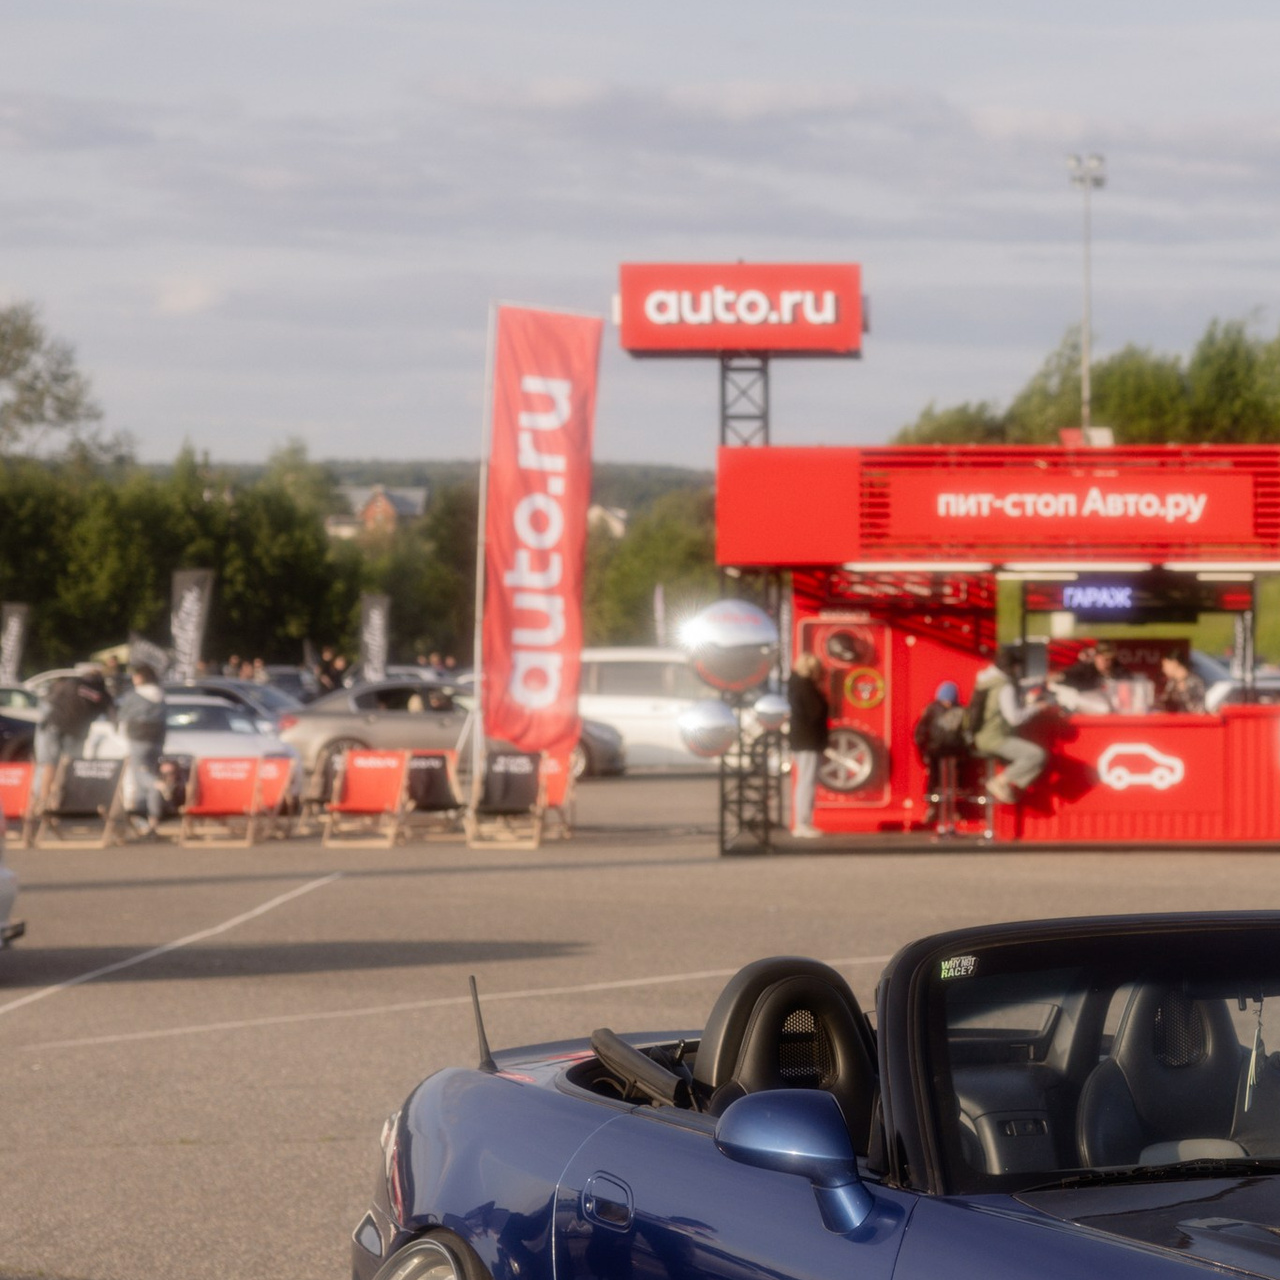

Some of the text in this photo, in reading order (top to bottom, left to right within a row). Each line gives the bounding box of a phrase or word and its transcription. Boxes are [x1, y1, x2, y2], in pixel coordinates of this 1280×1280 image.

[644, 285, 838, 326] auto.ru
[937, 486, 1208, 524] пит-стоп Авто.ру
[503, 373, 572, 710] auto.ru
[1063, 586, 1133, 609] ГАРАЖ
[940, 965, 974, 979] RACE?
[941, 959, 960, 971] WHY
[960, 956, 976, 968] NOT
